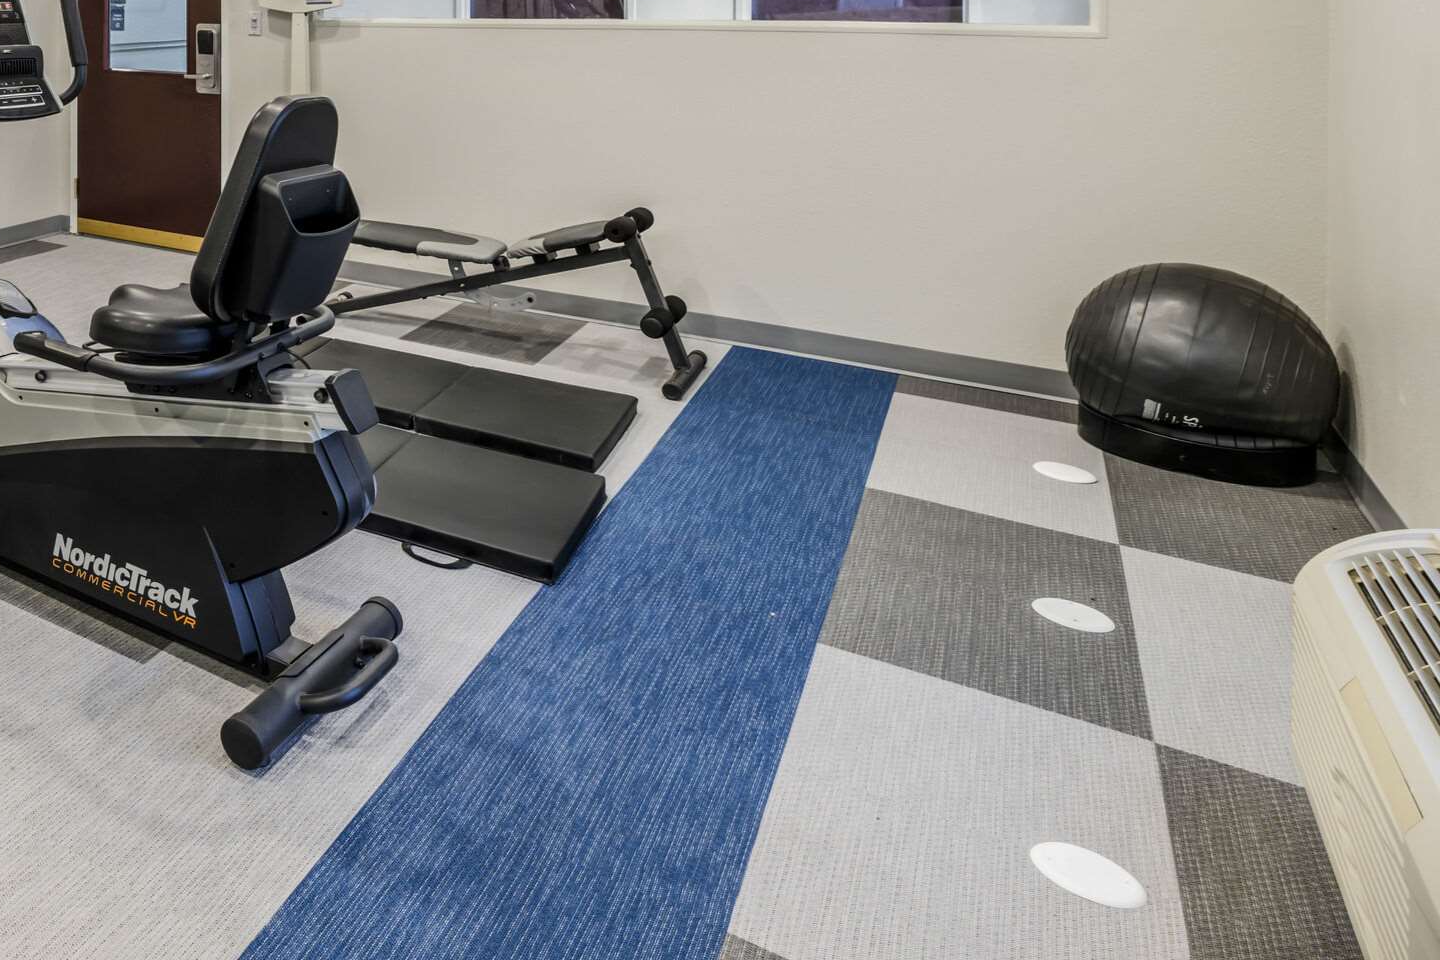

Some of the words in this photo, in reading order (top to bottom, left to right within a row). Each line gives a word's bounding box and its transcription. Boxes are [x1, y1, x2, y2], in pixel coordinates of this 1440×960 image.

[52, 532, 200, 619] NordicTrack
[52, 557, 168, 617] COMMERCIAL
[172, 610, 198, 629] VR
